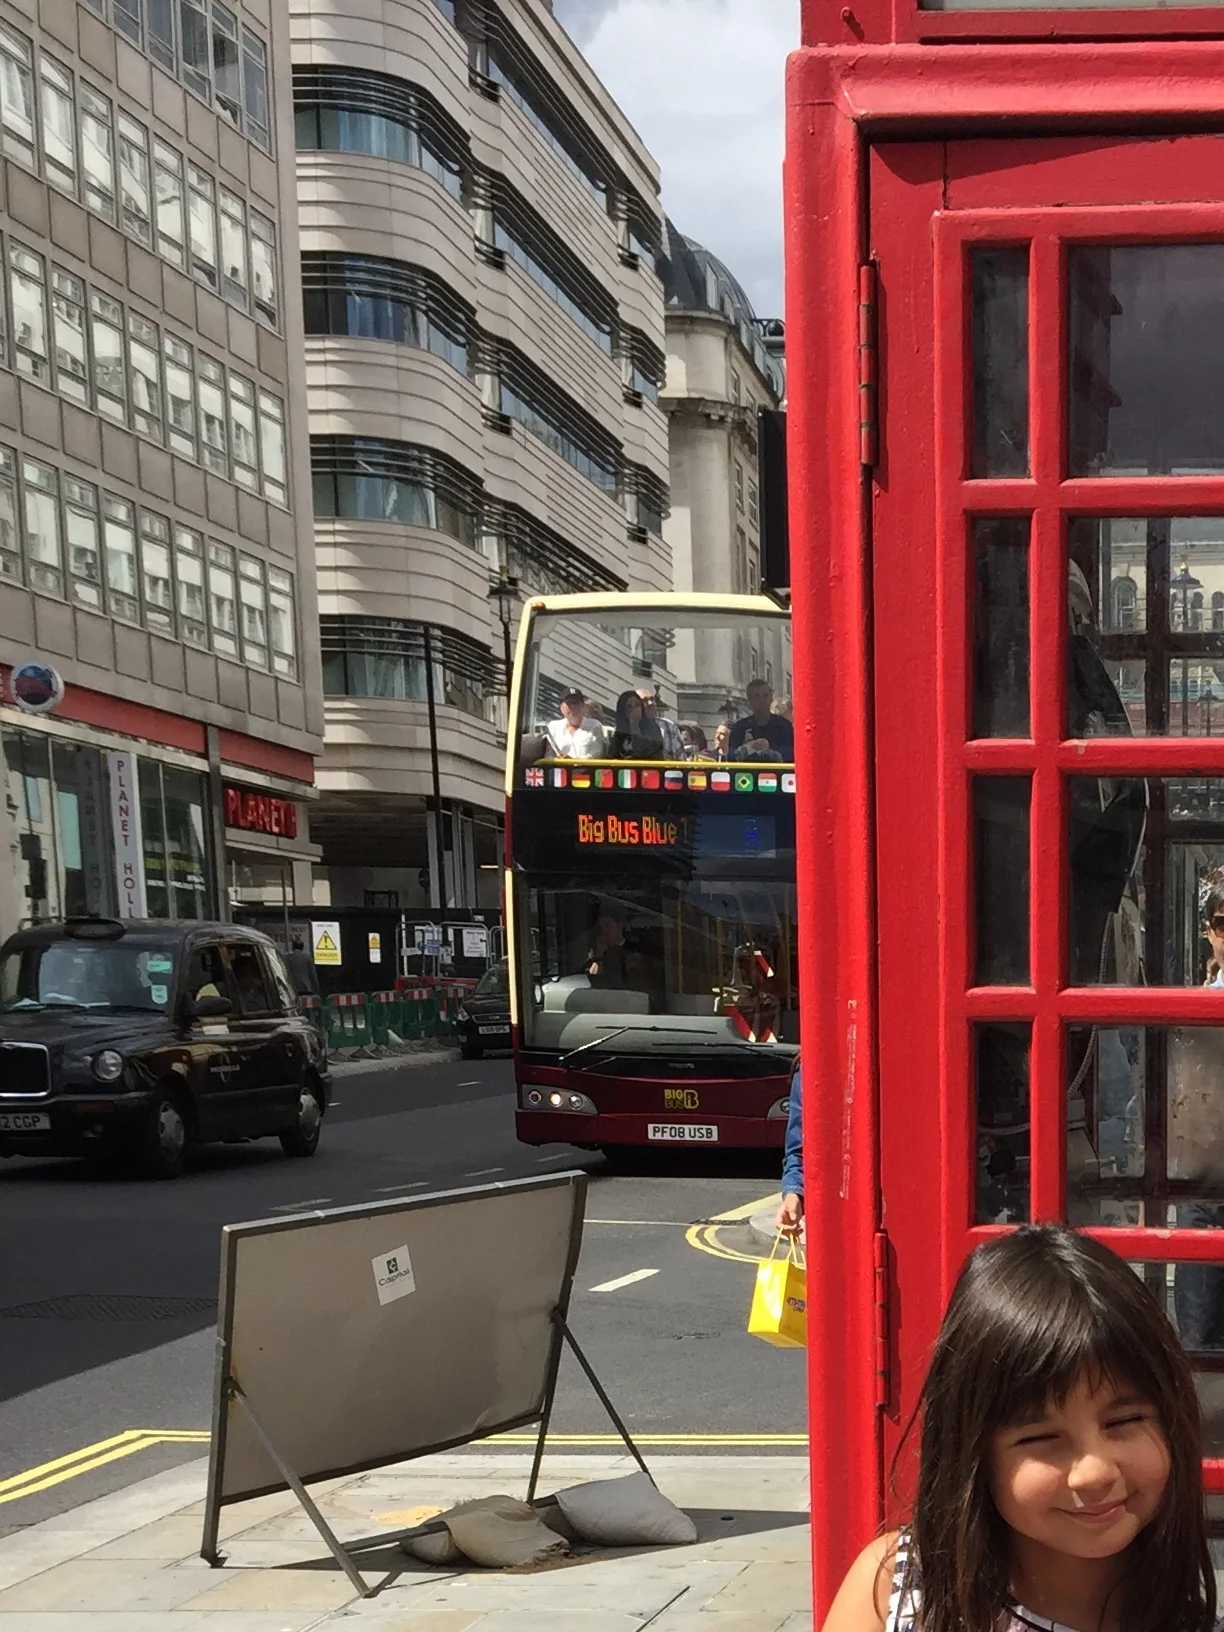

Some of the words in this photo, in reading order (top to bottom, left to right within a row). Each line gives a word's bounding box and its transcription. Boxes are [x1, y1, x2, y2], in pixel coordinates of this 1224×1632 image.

[116, 760, 129, 847] PLANET
[227, 788, 285, 835] PLANET
[578, 814, 605, 843] Big
[607, 815, 639, 844] Bus
[642, 816, 677, 845] Blue
[664, 1089, 684, 1099] BIG
[664, 1100, 684, 1109] BUS
[13, 1115, 40, 1129] CGP
[653, 1126, 686, 1138] PF08
[689, 1127, 713, 1139] USB
[379, 1268, 411, 1286] Capital
